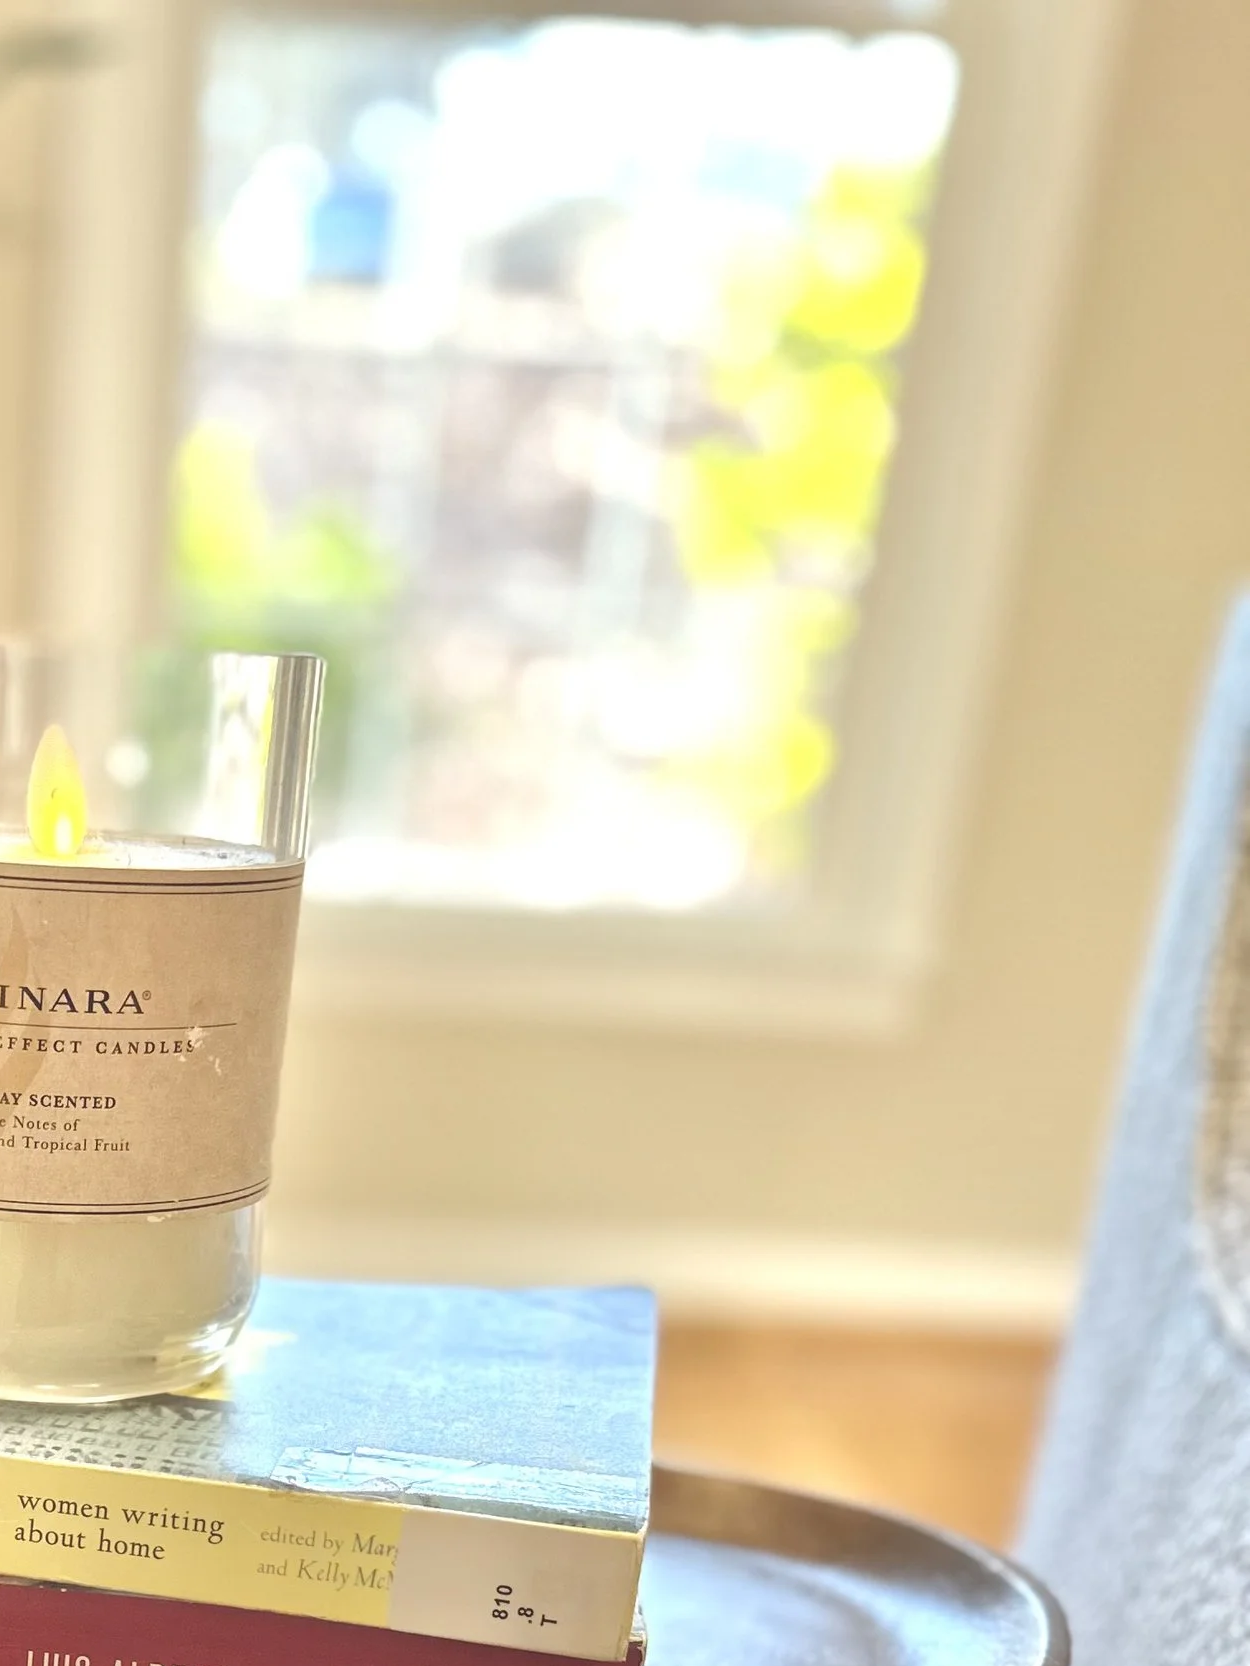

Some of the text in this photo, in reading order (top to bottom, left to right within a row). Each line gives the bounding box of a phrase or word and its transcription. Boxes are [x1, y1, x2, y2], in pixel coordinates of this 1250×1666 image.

[95, 1040, 195, 1055] CANDLES
[29, 1093, 117, 1110] SCENTED
[13, 1115, 57, 1131] Notes
[63, 1118, 81, 1132] of
[21, 1135, 87, 1154] Tropical
[94, 1138, 131, 1152] Fruit
[17, 1493, 225, 1545] women writing
[14, 1518, 166, 1560] about home
[260, 1526, 317, 1548] edited
[323, 1531, 345, 1557] by
[256, 1559, 288, 1577] and
[297, 1558, 350, 1592] Kelly
[492, 1584, 513, 1620] 810
[517, 1606, 535, 1624] .8
[540, 1614, 558, 1627] T
